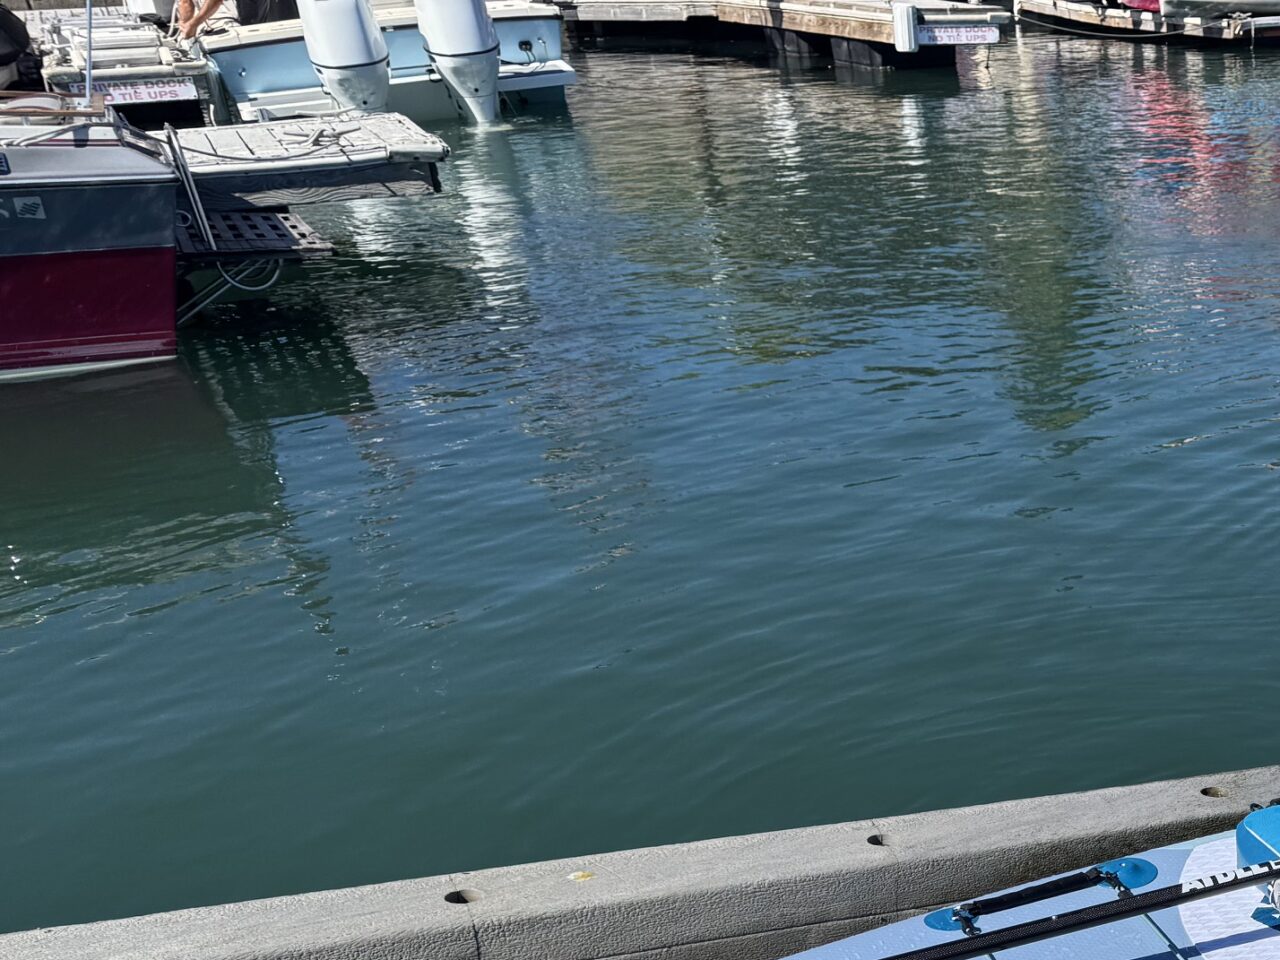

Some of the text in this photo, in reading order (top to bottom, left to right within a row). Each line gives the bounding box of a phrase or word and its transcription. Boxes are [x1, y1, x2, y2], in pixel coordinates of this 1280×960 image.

[919, 25, 995, 34] PRIVATE DOCK
[927, 34, 988, 43] NO TIE UPS
[145, 79, 188, 89] DOCK
[119, 92, 143, 101] TIE
[147, 90, 180, 100] UPS
